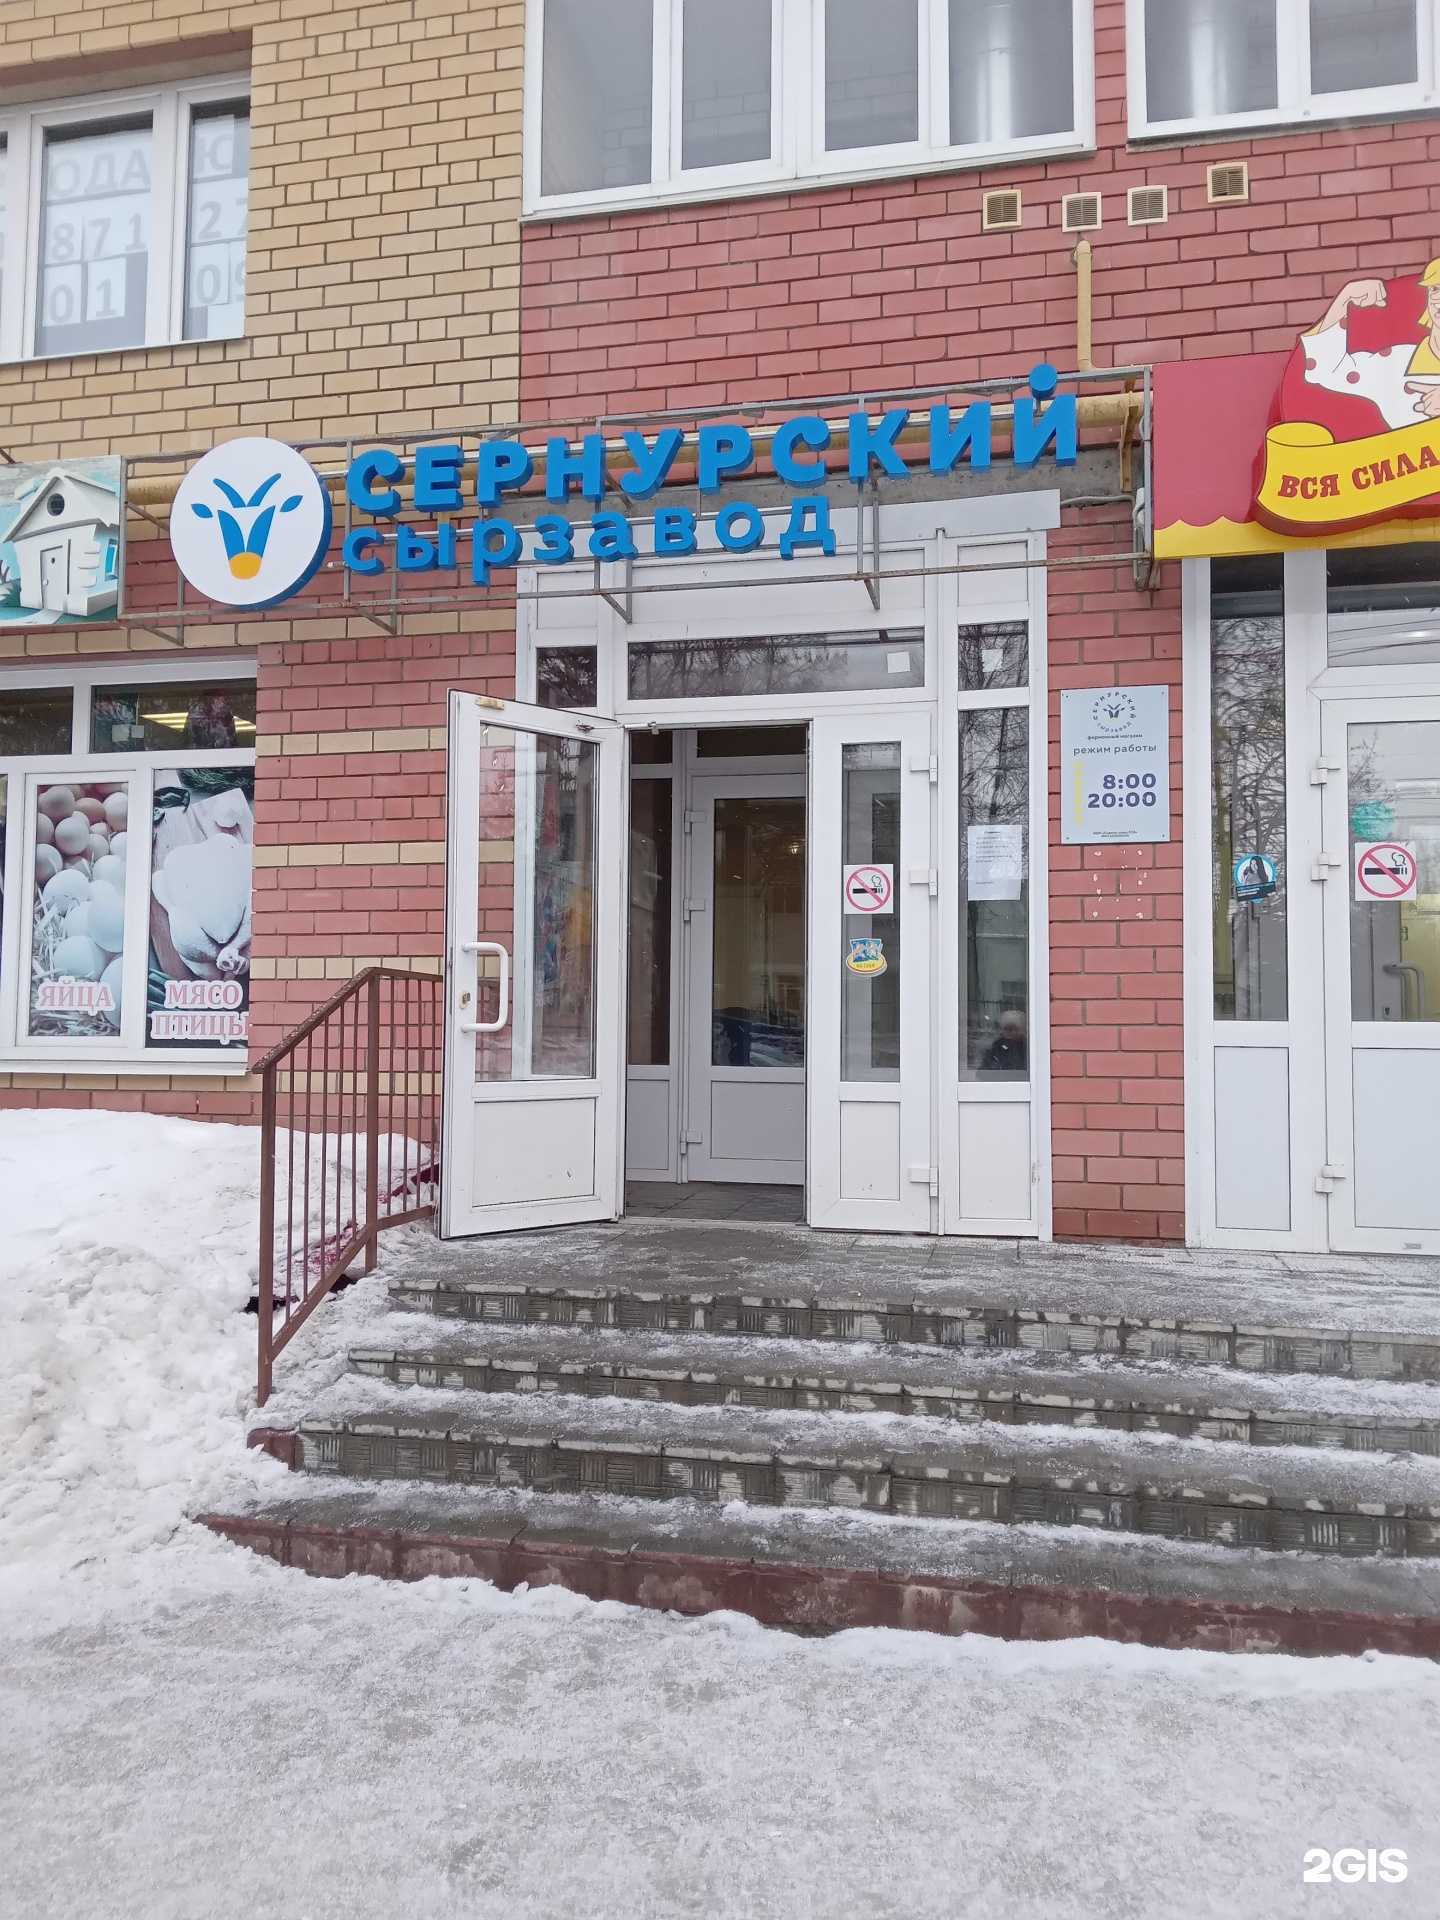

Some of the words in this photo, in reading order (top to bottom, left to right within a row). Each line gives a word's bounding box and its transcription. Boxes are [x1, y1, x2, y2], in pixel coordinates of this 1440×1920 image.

[346, 363, 1078, 517] СЕРНУРСКИЙ
[1277, 473, 1341, 500] ВСЯ
[1351, 445, 1440, 490] СИЛА
[343, 496, 837, 587] сырзавод
[1073, 746, 1111, 757] режим
[1114, 744, 1157, 755] работы
[1102, 773, 1157, 790] 8:00
[1087, 791, 1157, 809] 20:00
[38, 978, 113, 1014] ЯЙЦА
[166, 983, 241, 1007] МЯСО
[152, 1013, 248, 1042] ПТИЦЫ
